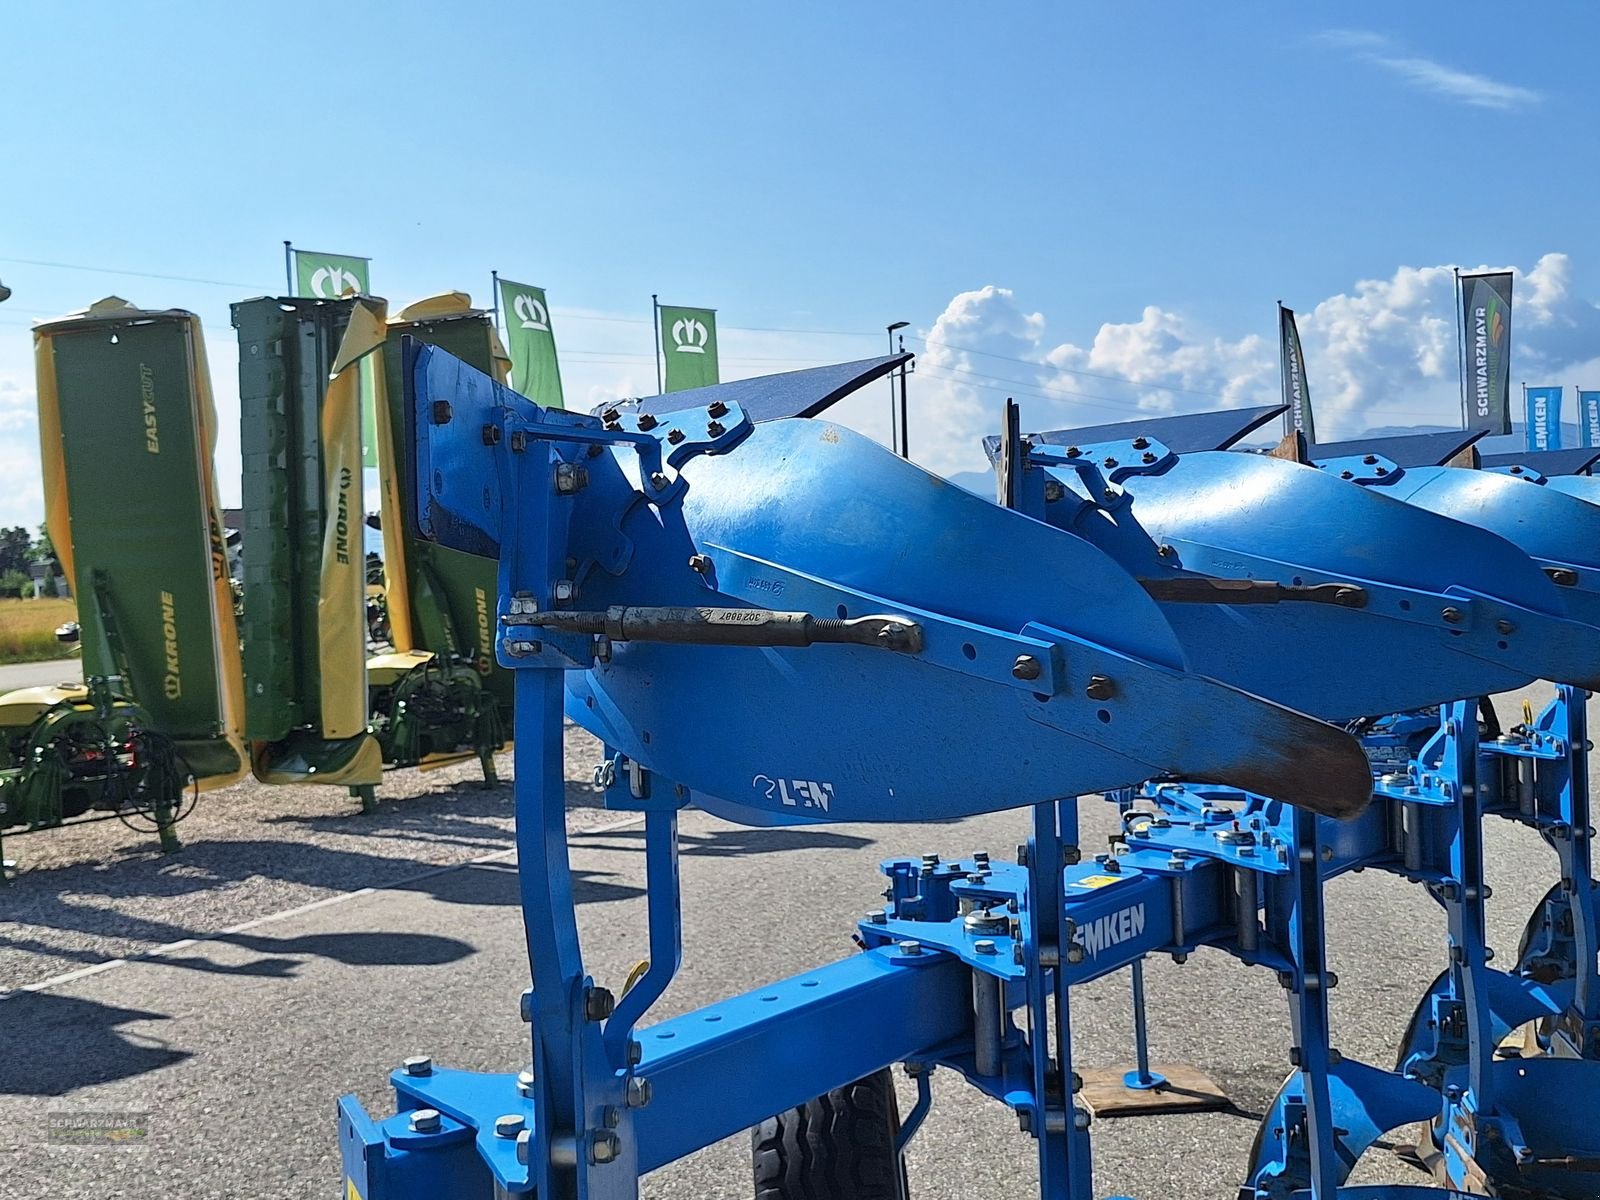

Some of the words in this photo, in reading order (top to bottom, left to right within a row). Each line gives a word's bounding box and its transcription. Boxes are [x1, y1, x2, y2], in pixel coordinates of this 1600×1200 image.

[1475, 307, 1489, 417] SCHWARZMAYR
[1588, 400, 1600, 448] EMKEN
[336, 492, 350, 565] KRONE
[161, 590, 180, 675] KRONE
[475, 587, 491, 655] KRONE
[1072, 902, 1145, 962] EMKEN
